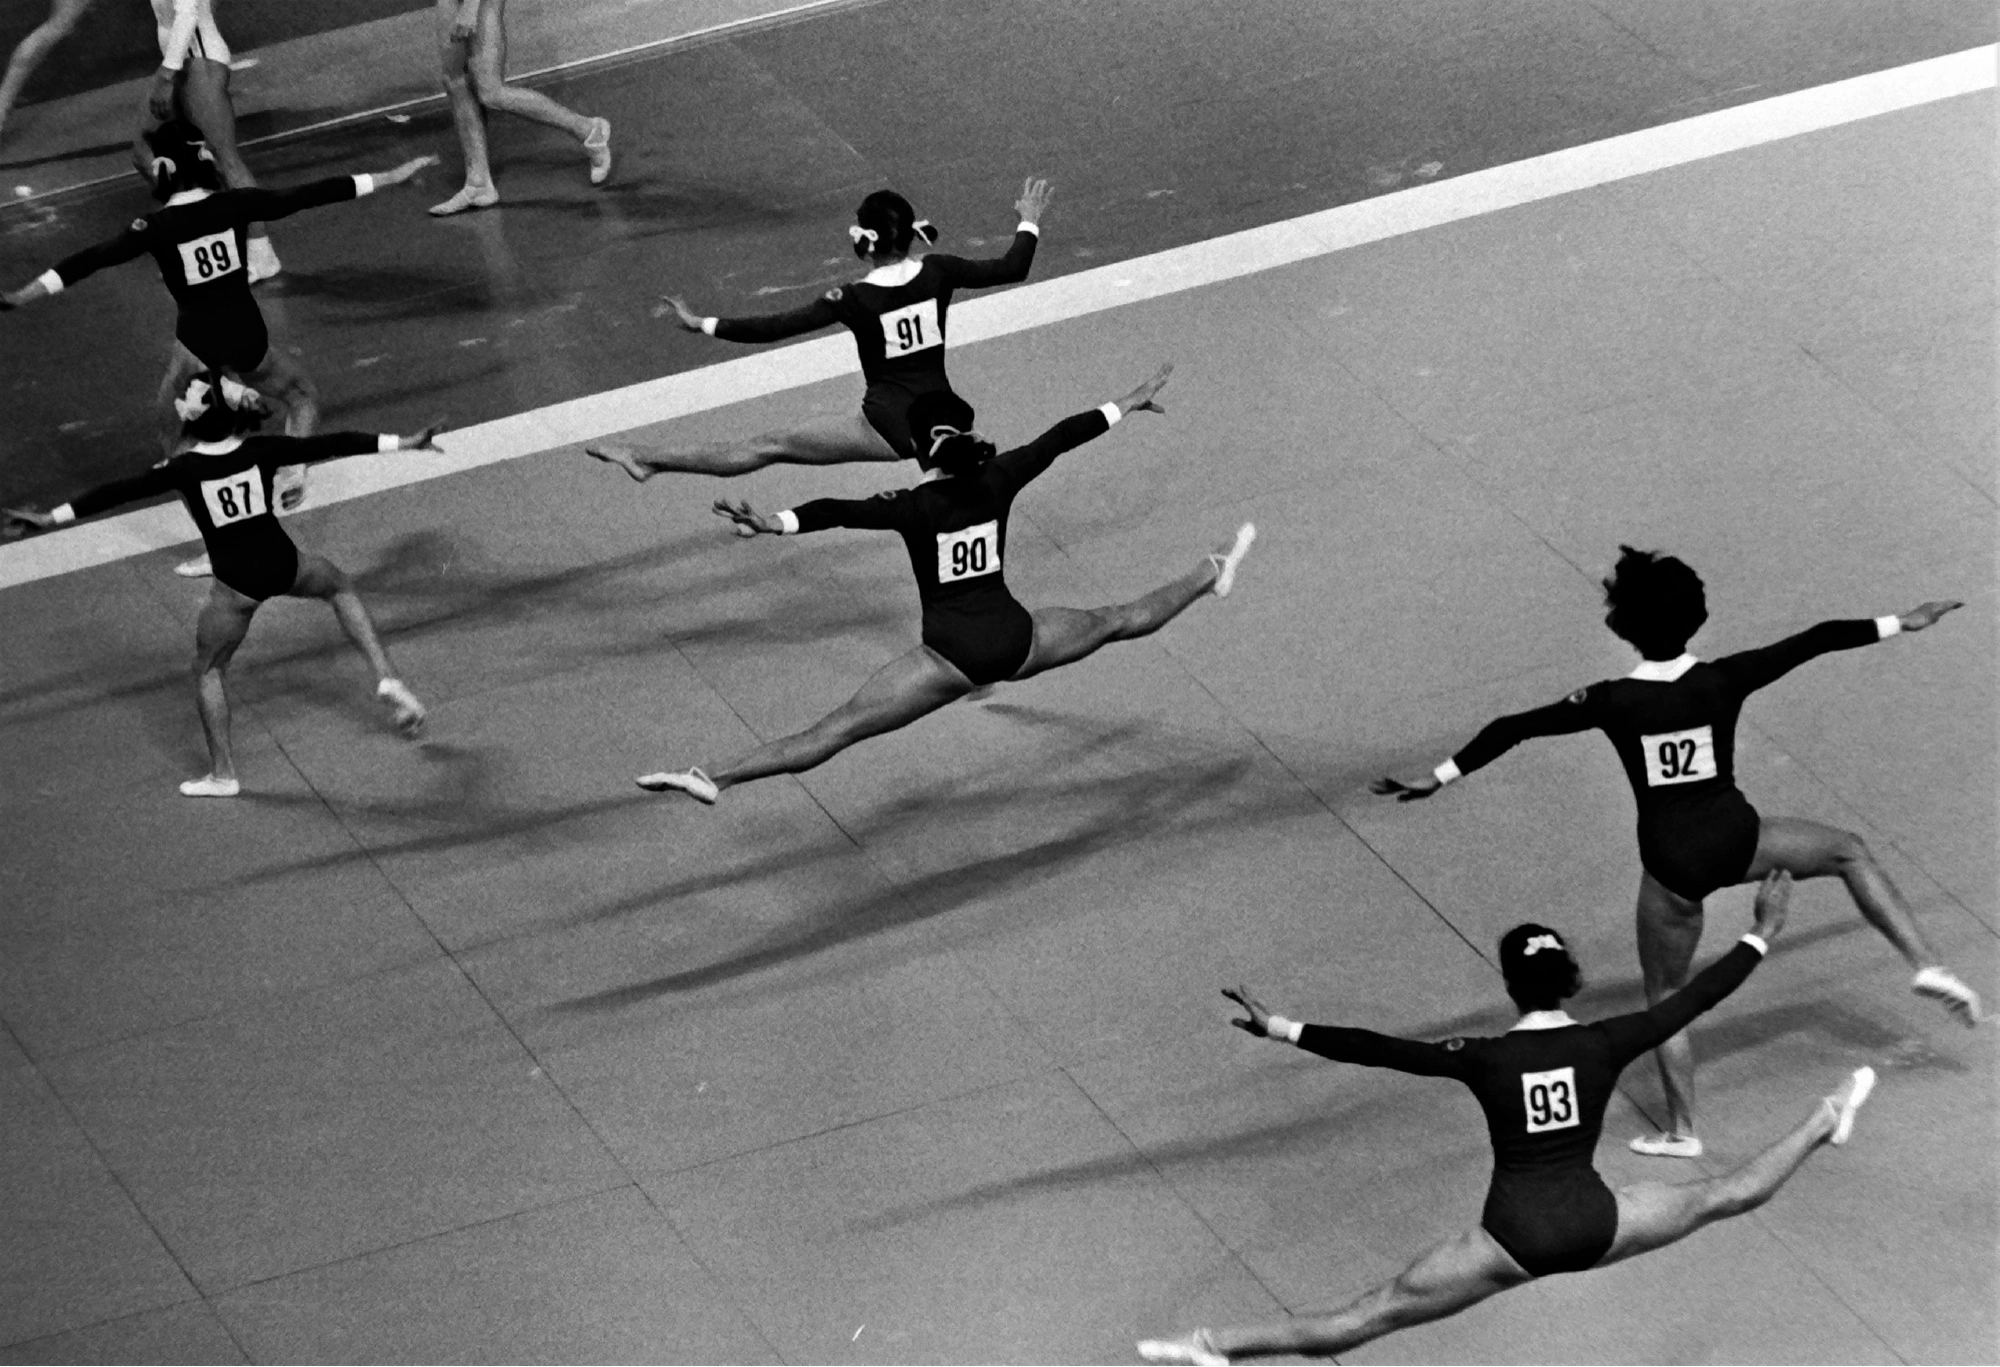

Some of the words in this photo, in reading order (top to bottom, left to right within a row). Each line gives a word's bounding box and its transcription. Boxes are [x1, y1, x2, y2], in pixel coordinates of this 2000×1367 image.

[193, 240, 232, 279] 89
[896, 314, 924, 351] 91
[216, 480, 252, 519] 87
[951, 536, 987, 577] 90
[1658, 738, 1700, 779] 92
[1529, 1080, 1572, 1127] 93
